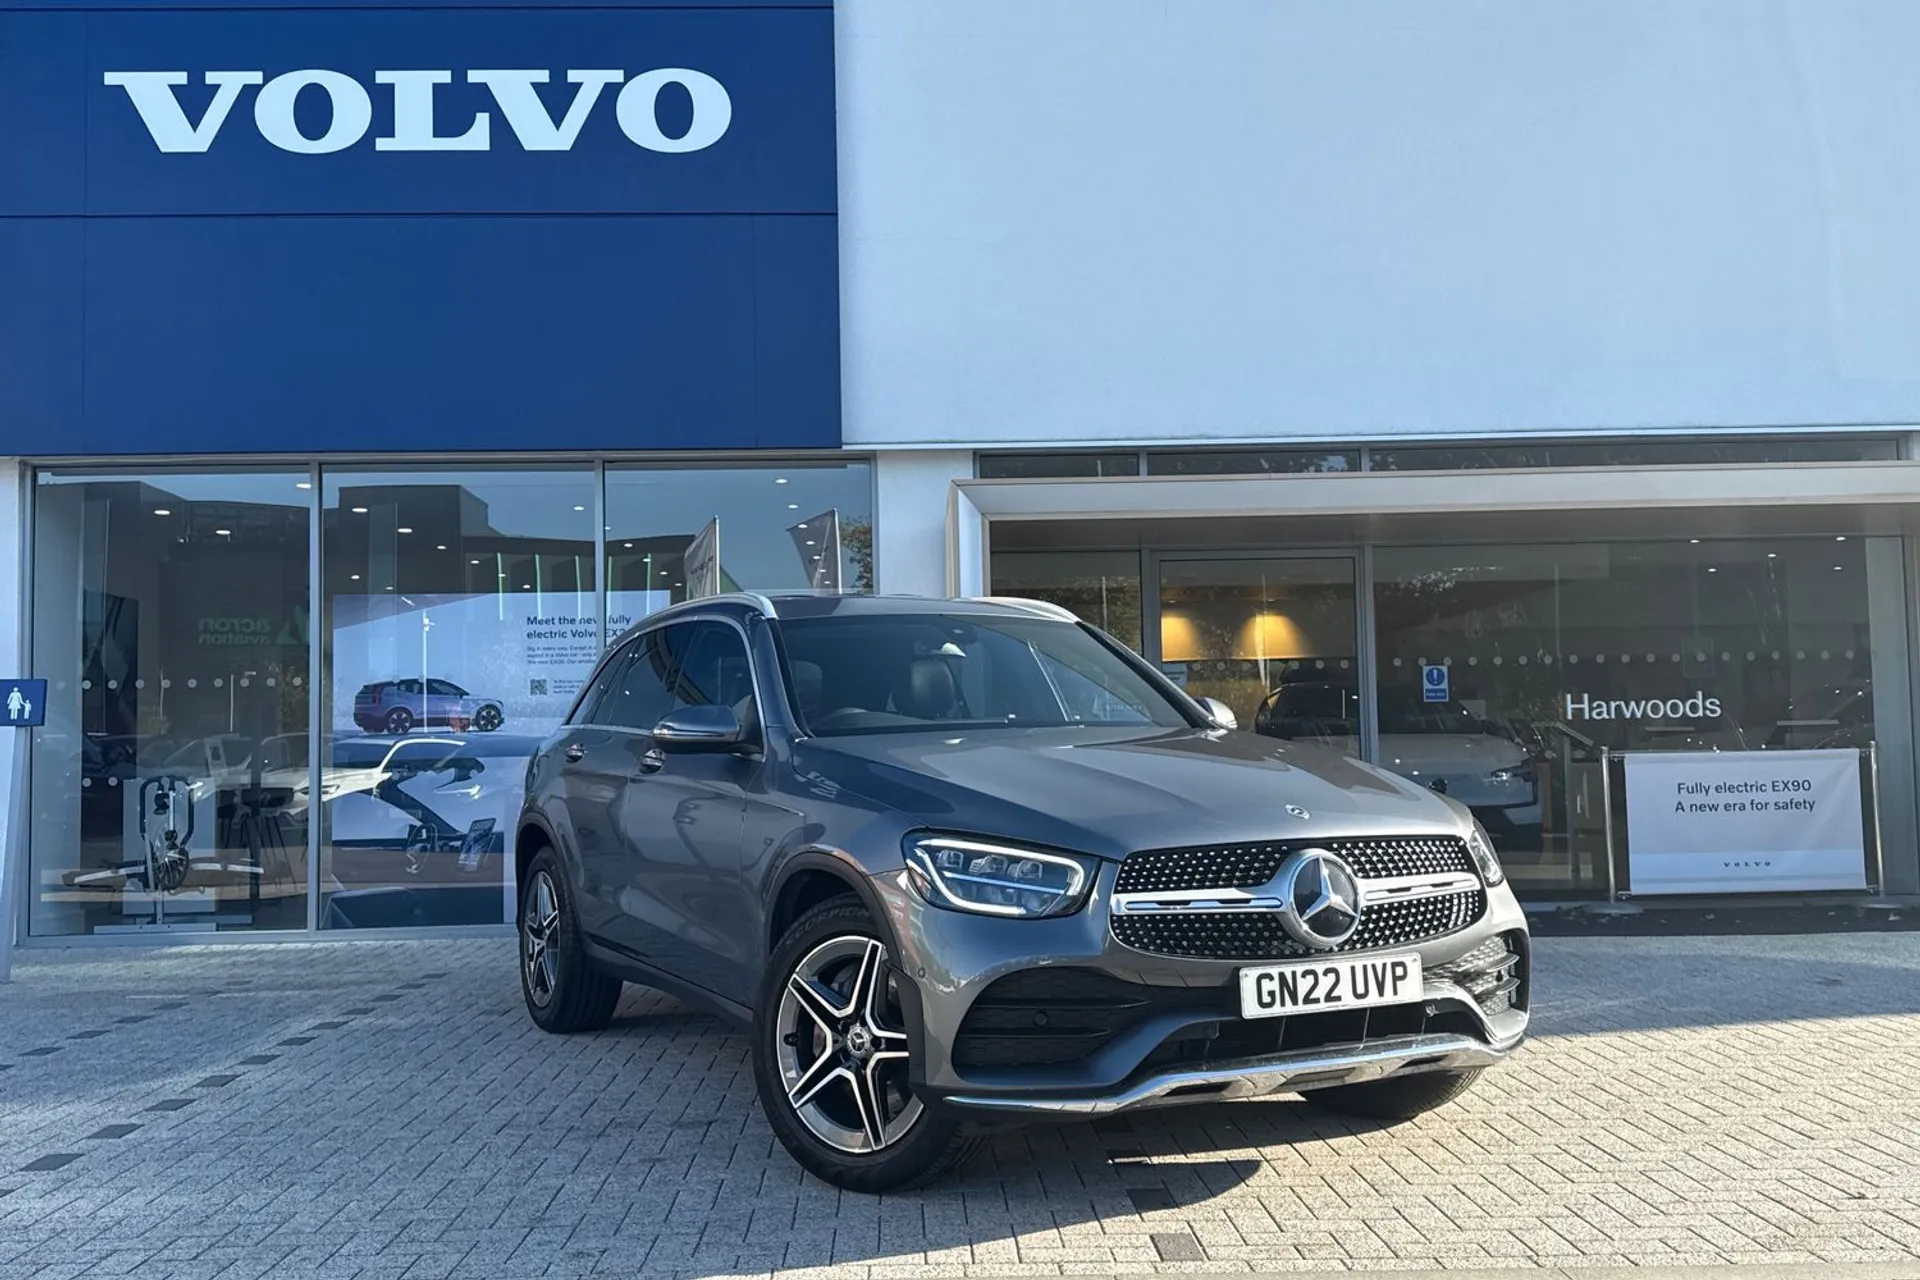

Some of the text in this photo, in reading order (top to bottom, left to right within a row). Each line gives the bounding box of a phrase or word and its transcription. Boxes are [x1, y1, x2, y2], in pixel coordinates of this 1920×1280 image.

[104, 68, 732, 154] VOLVO
[526, 616, 555, 625] Meet
[559, 616, 576, 625] the
[608, 615, 631, 625] fully
[526, 629, 567, 639] electric
[1565, 690, 1722, 720] Harwoods
[1677, 779, 1812, 796] Fully electric EX90
[1675, 798, 1816, 813] A new era for safety
[1256, 961, 1408, 1009] GN22 UVP
